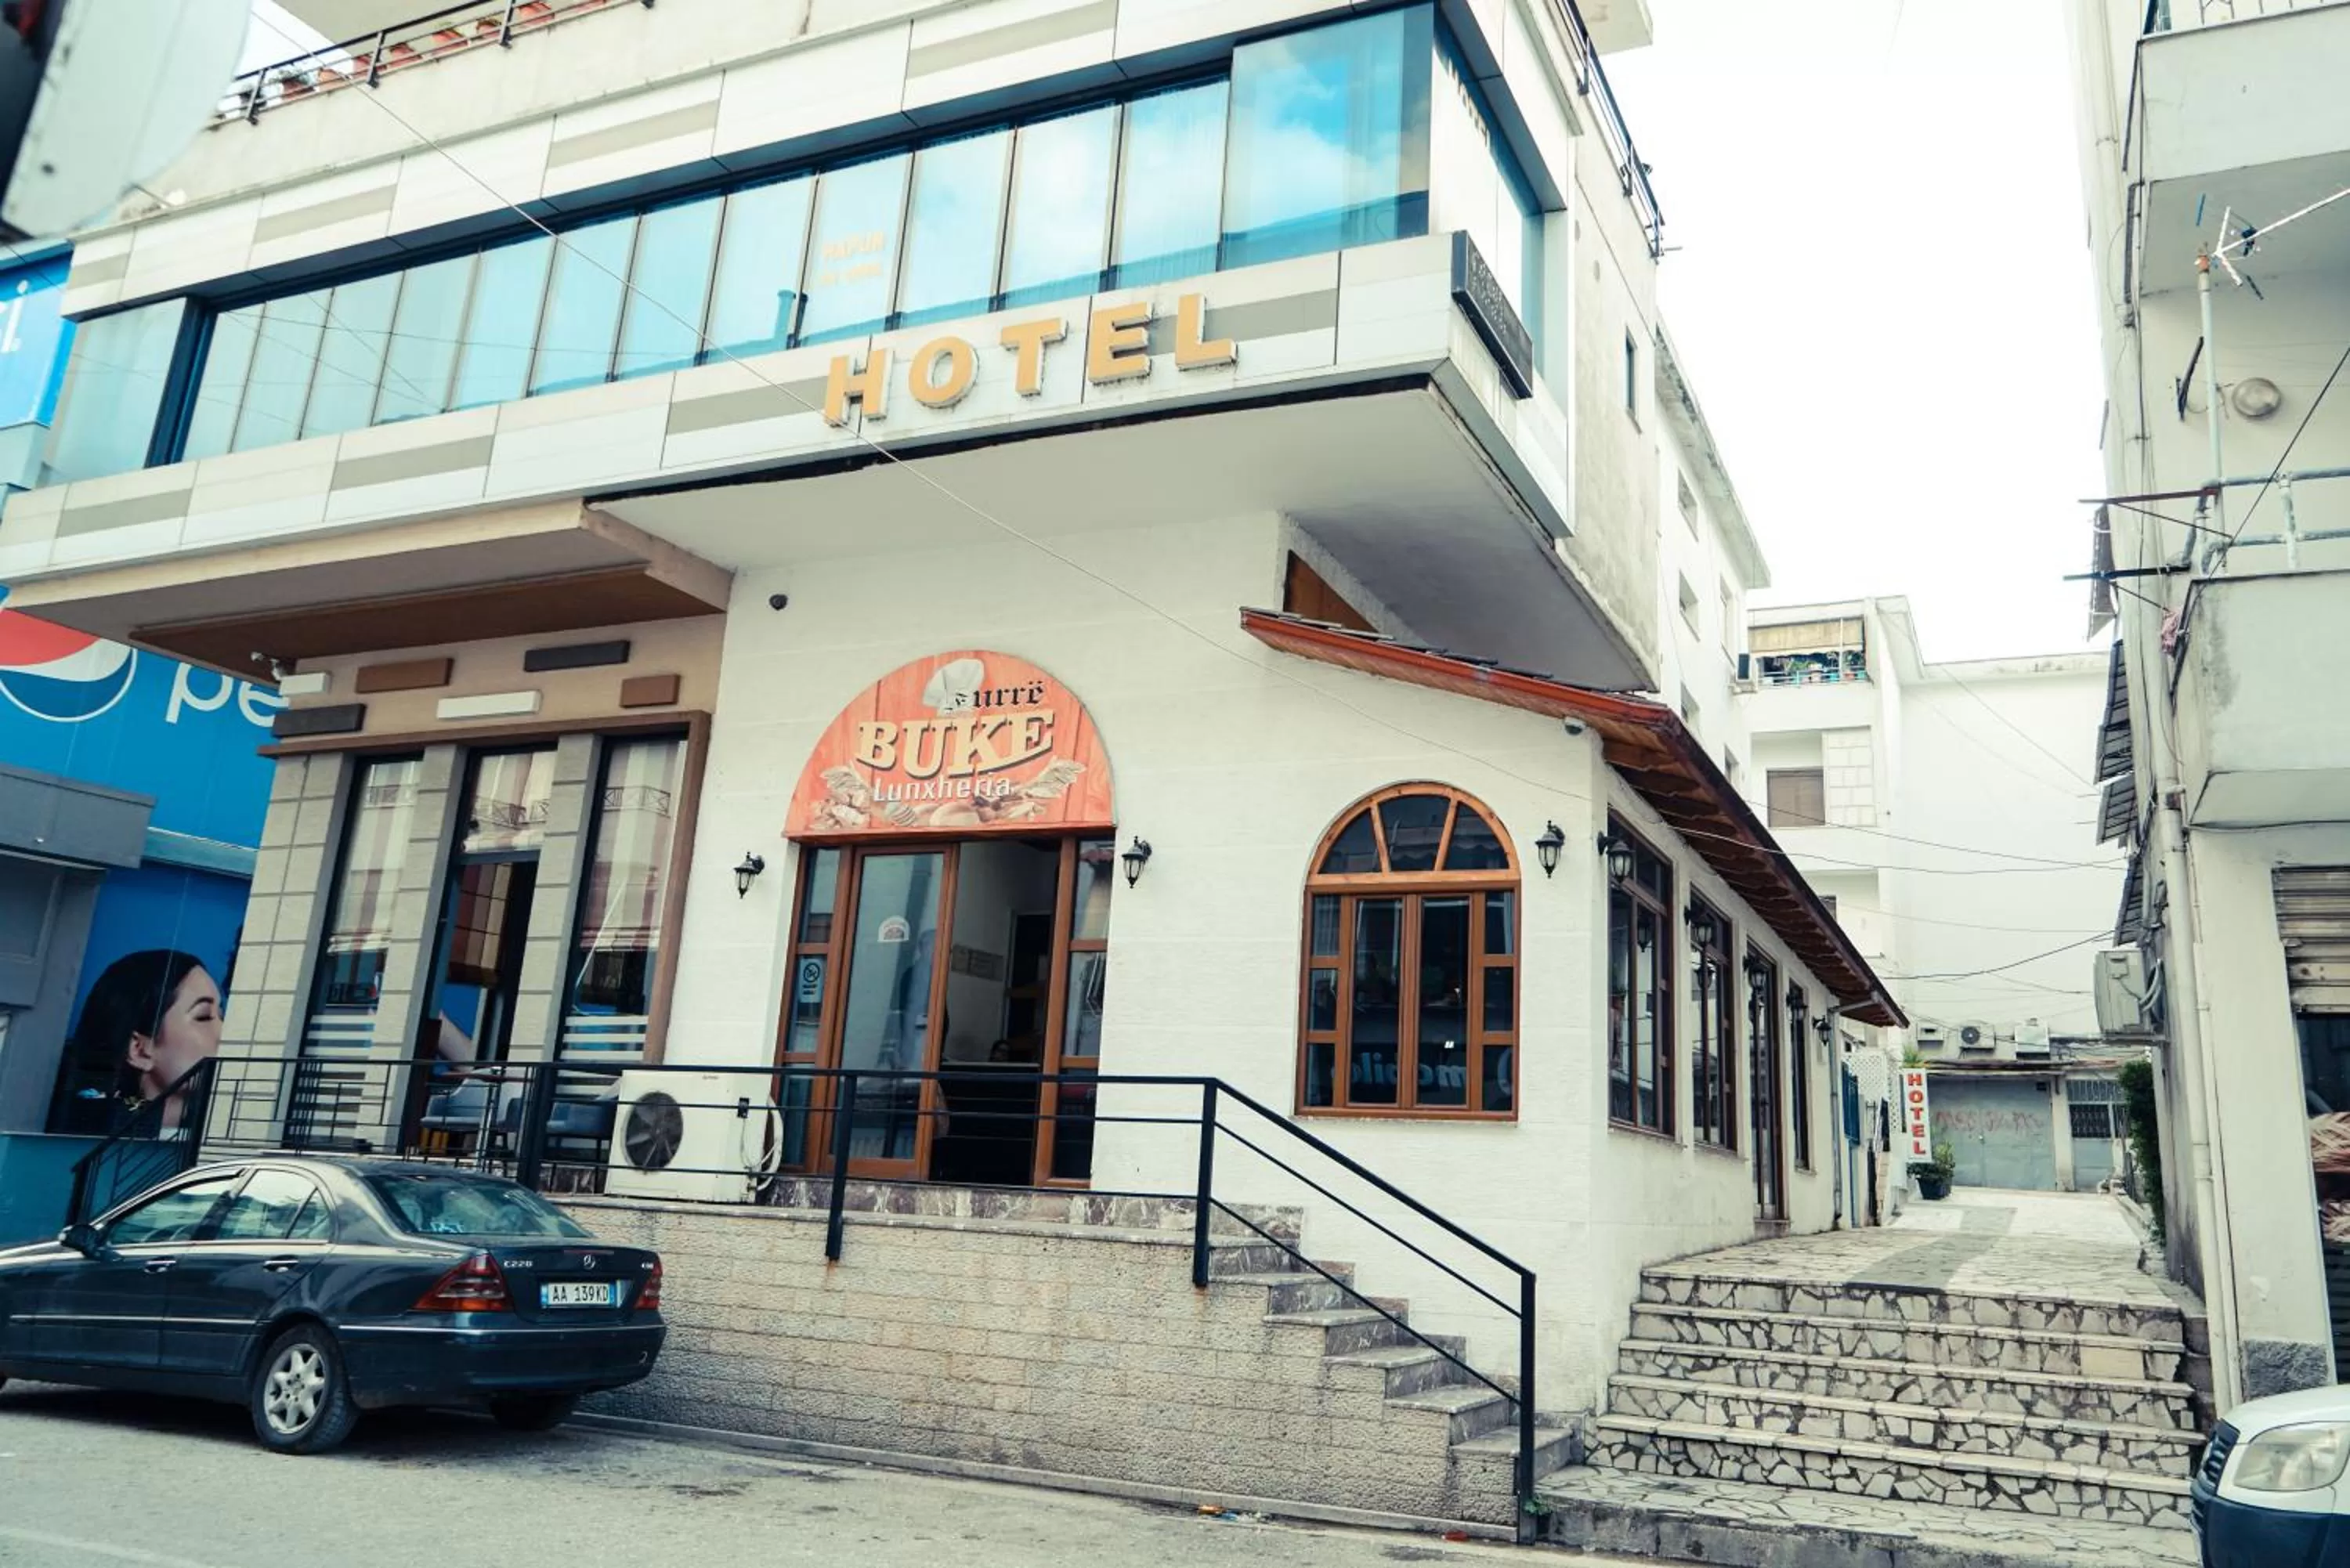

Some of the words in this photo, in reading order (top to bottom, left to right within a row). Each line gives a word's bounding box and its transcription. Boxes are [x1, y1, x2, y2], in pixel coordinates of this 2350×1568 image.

[822, 292, 1238, 428] HOTEL
[856, 709, 1055, 779] BUKE
[873, 772, 1010, 802] Lunxheria
[1907, 1073, 1926, 1155] HOTEL
[552, 1286, 568, 1302] AA
[575, 1285, 609, 1302] 139KD
